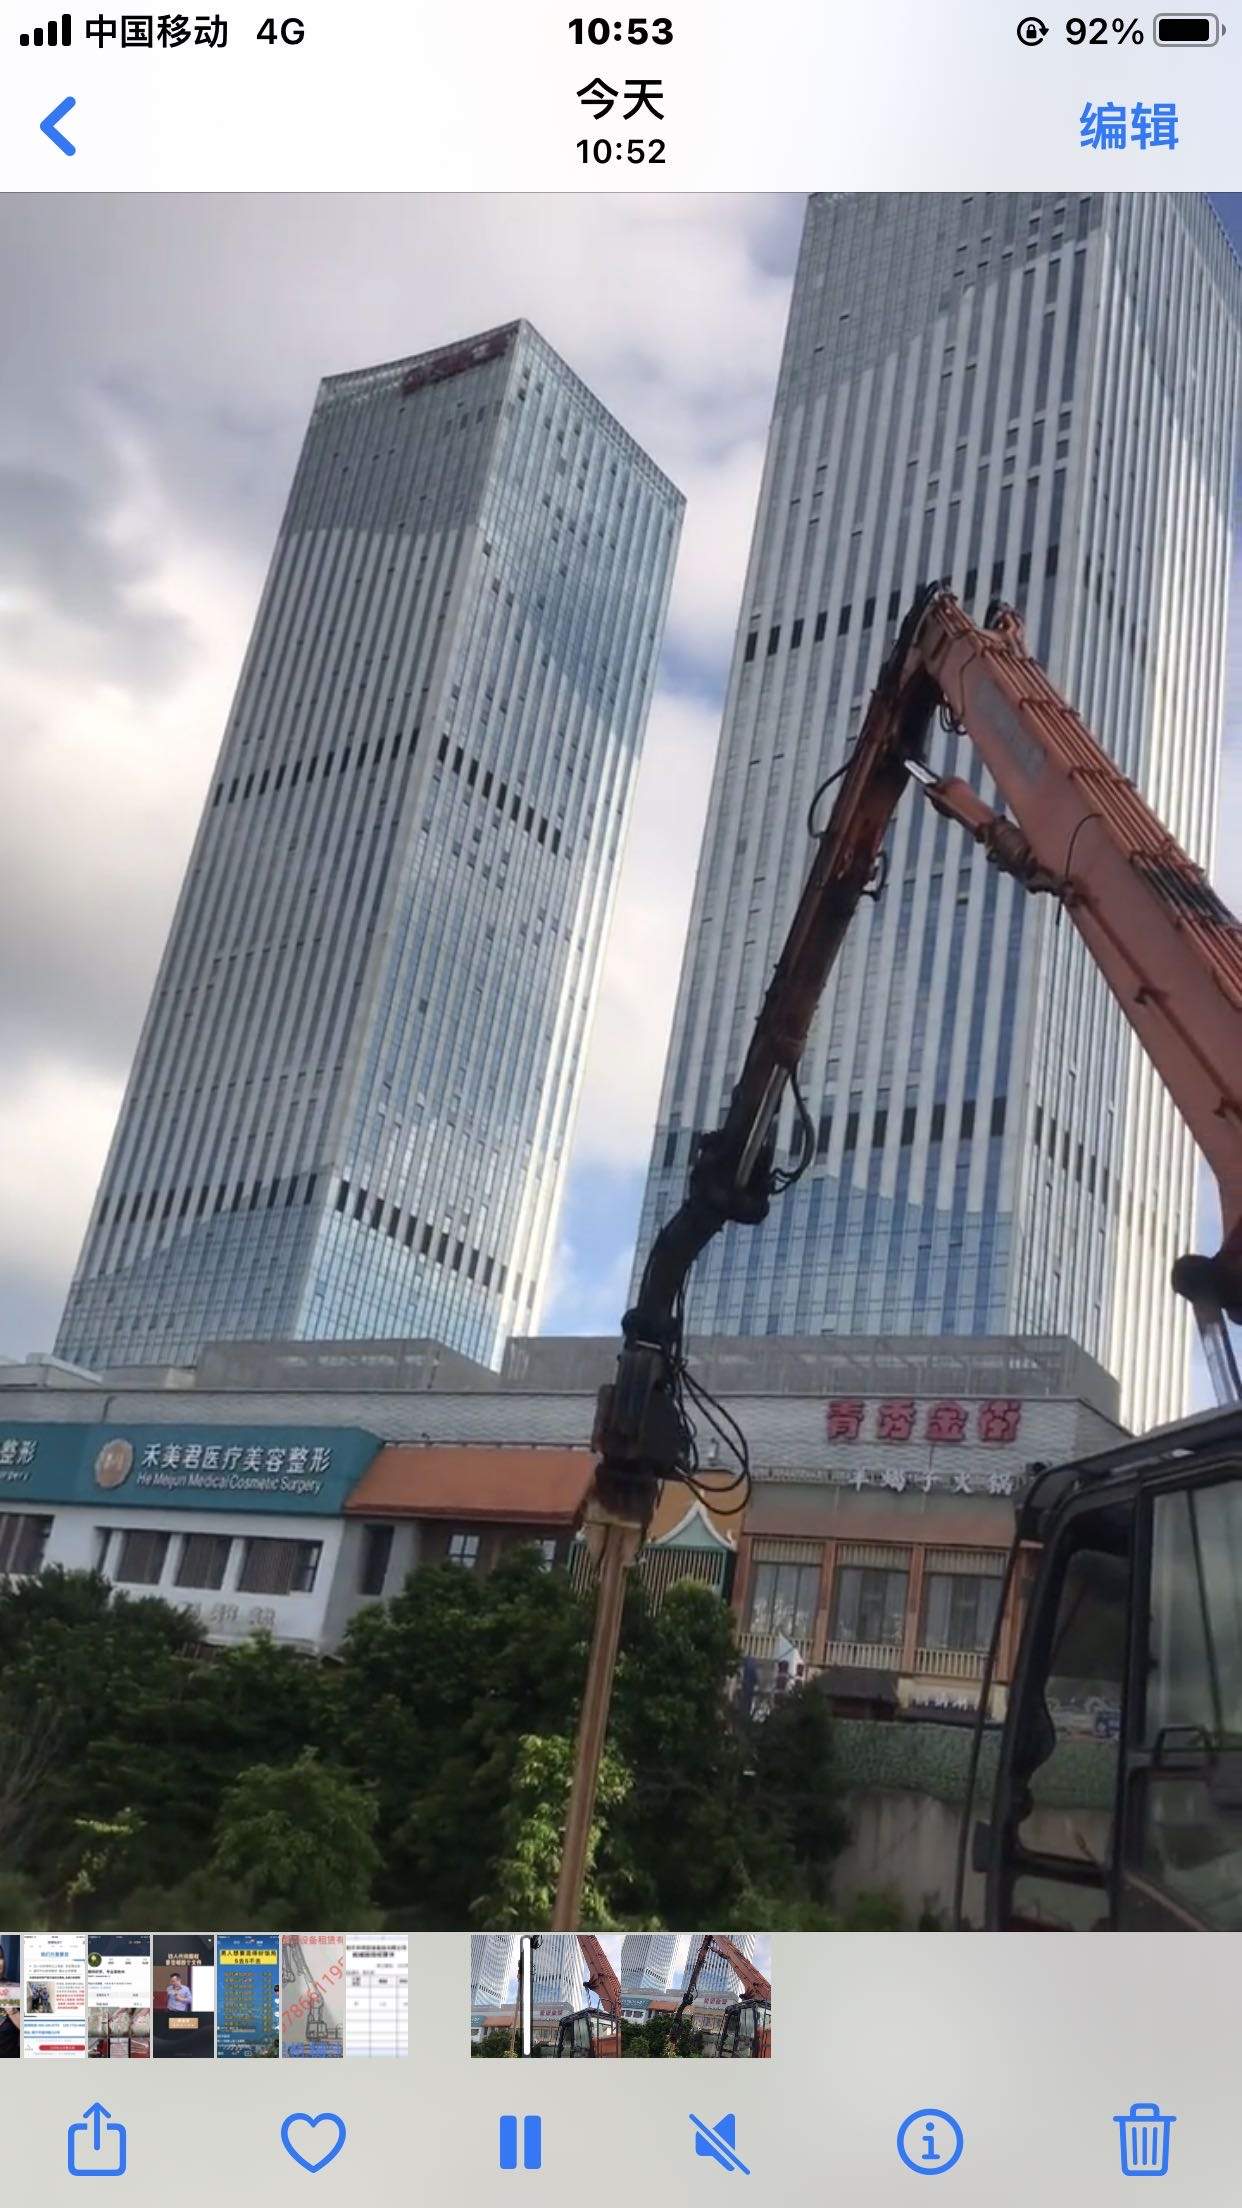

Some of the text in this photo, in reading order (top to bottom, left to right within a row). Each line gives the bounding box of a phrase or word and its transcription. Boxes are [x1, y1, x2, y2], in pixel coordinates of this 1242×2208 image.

[142, 1442, 331, 1474] 禾美君医疗美容整形
[187, 1472, 228, 1489] Medical
[228, 1472, 279, 1491] Cosmetic
[280, 1475, 321, 1496] Surgery
